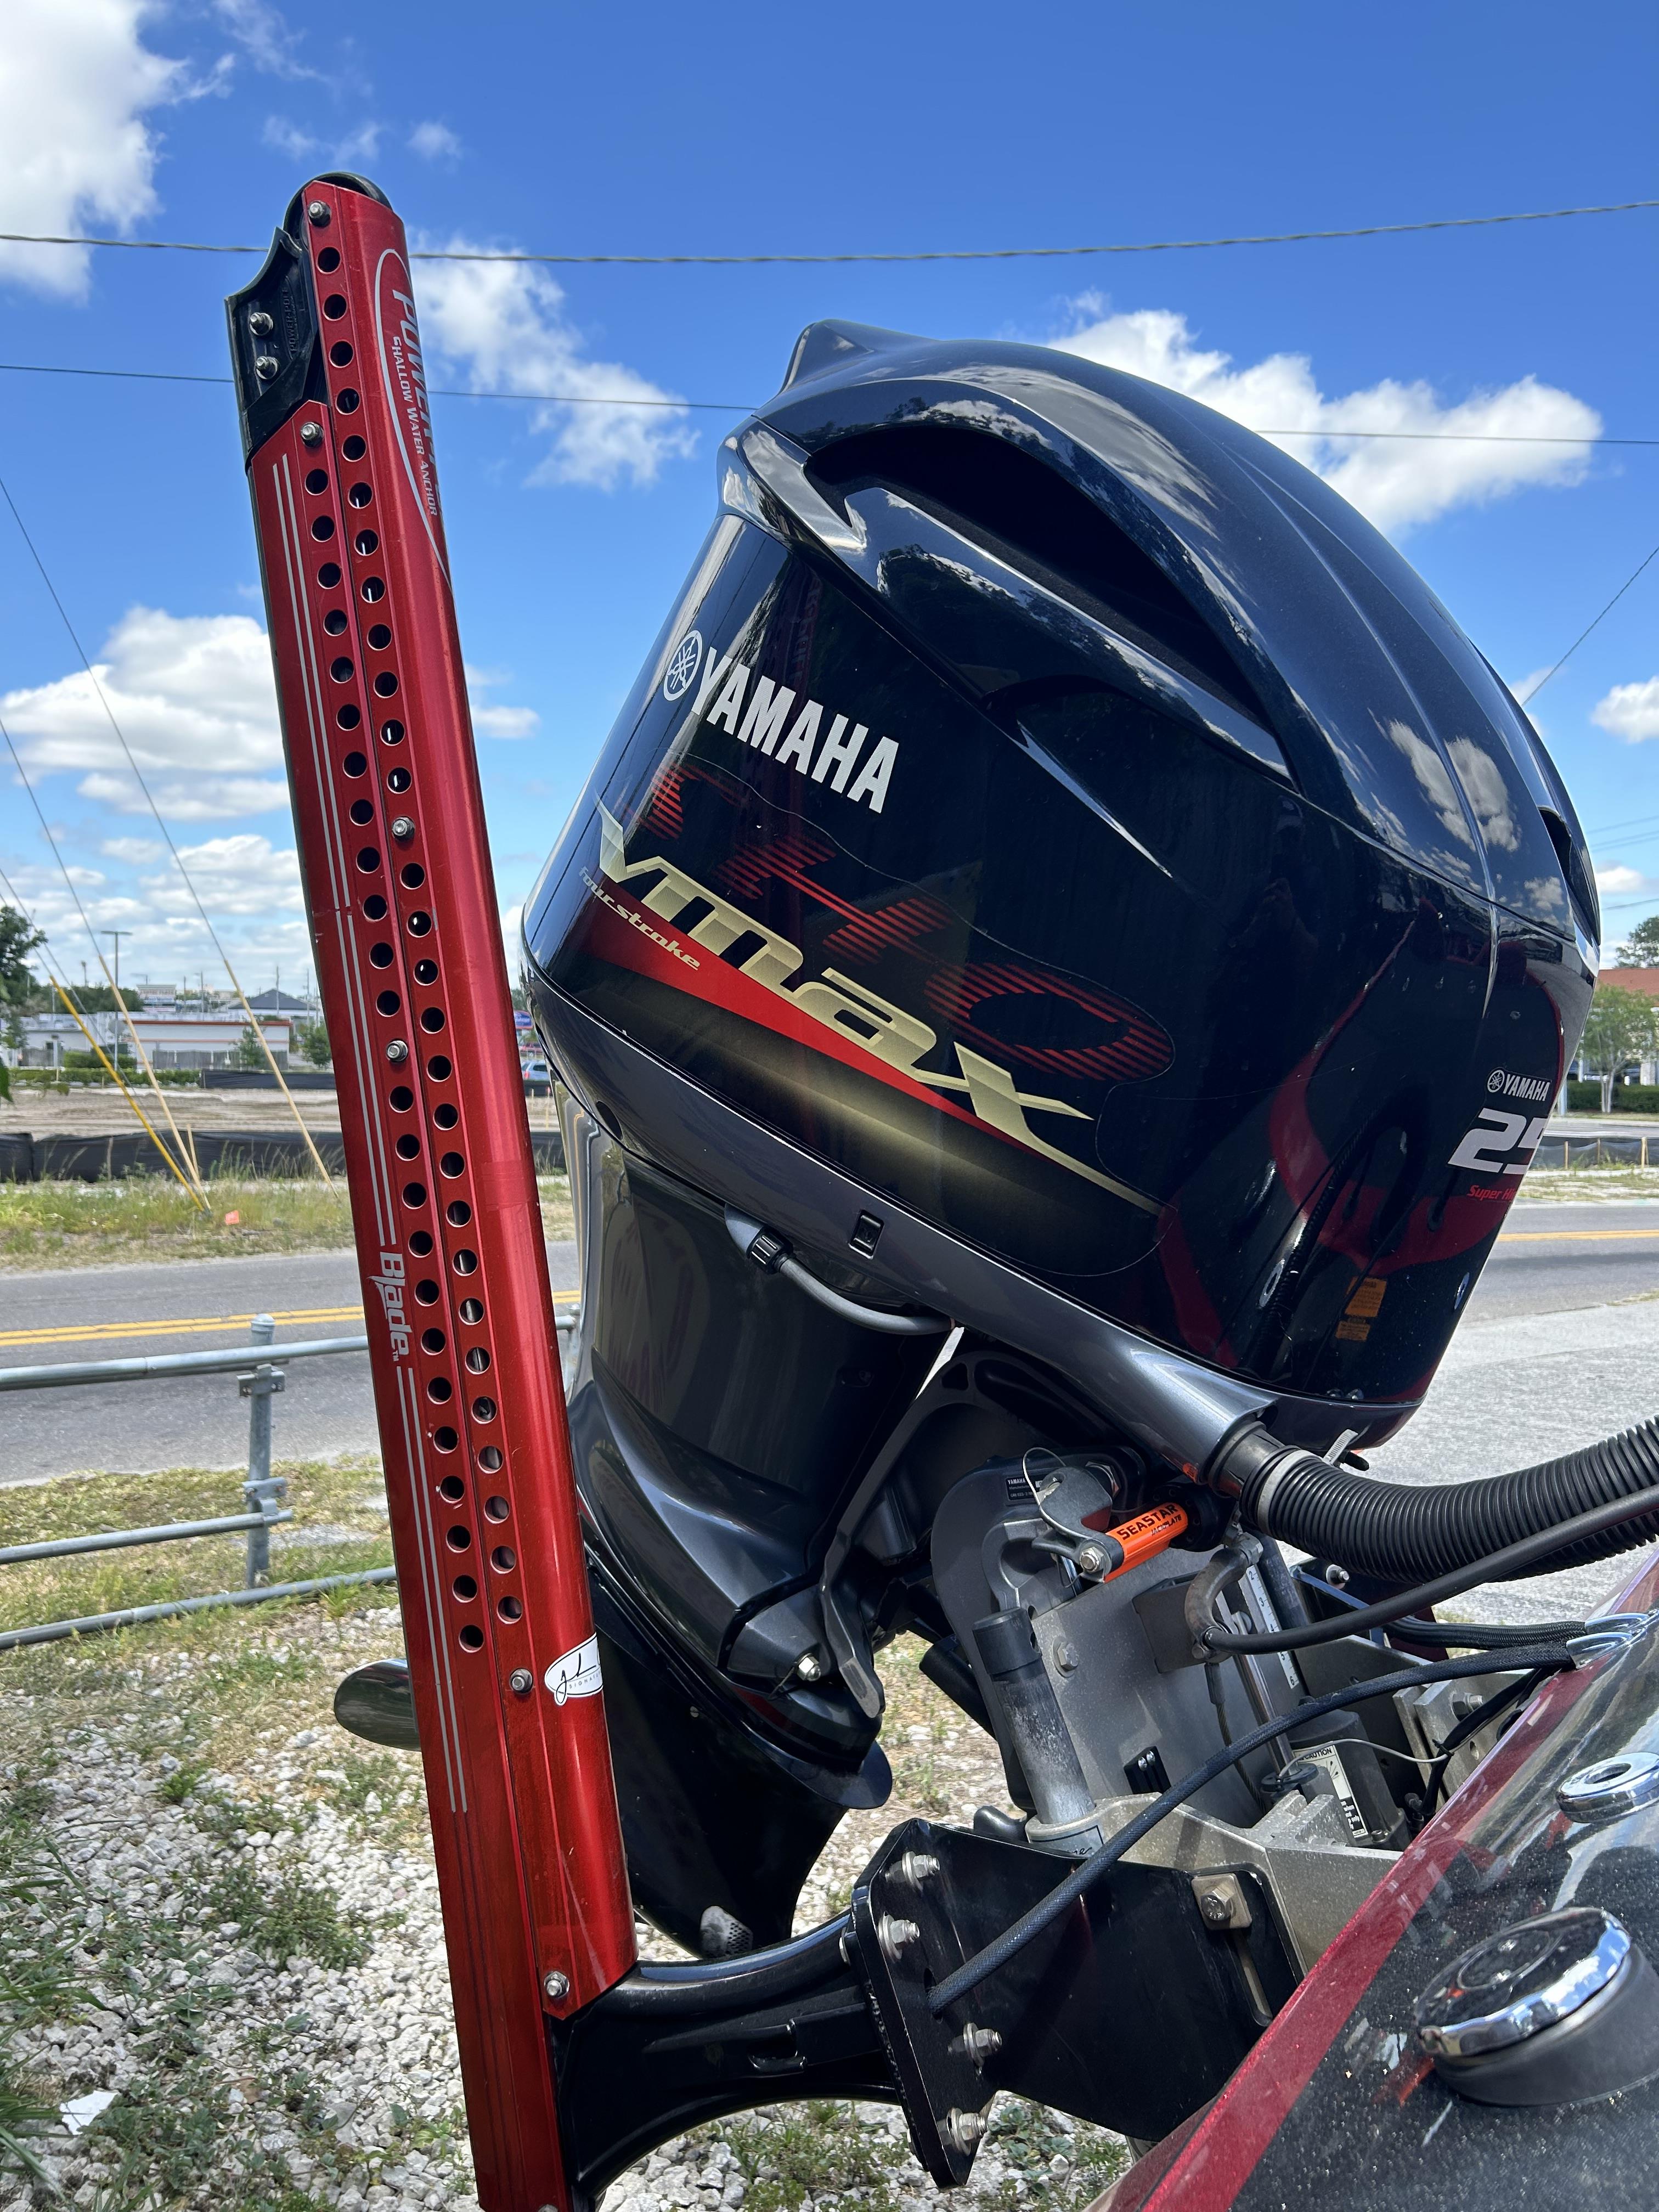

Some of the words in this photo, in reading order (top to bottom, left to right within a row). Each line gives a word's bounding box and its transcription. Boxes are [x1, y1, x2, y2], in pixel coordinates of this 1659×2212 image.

[392, 336, 414, 403] SHALLOW
[407, 407, 425, 455] WATER
[420, 460, 438, 516] ANCHOR
[691, 646, 900, 814] YAMAHA
[1503, 1074, 1550, 1102] YAMAHA
[1466, 1185, 1502, 1201] Super
[366, 1251, 413, 1356] Blade
[1116, 1504, 1178, 1541] SEASTAR
[1249, 1571, 1255, 1581] 2
[1259, 1597, 1265, 1607] 3
[1289, 1675, 1295, 1686] 6
